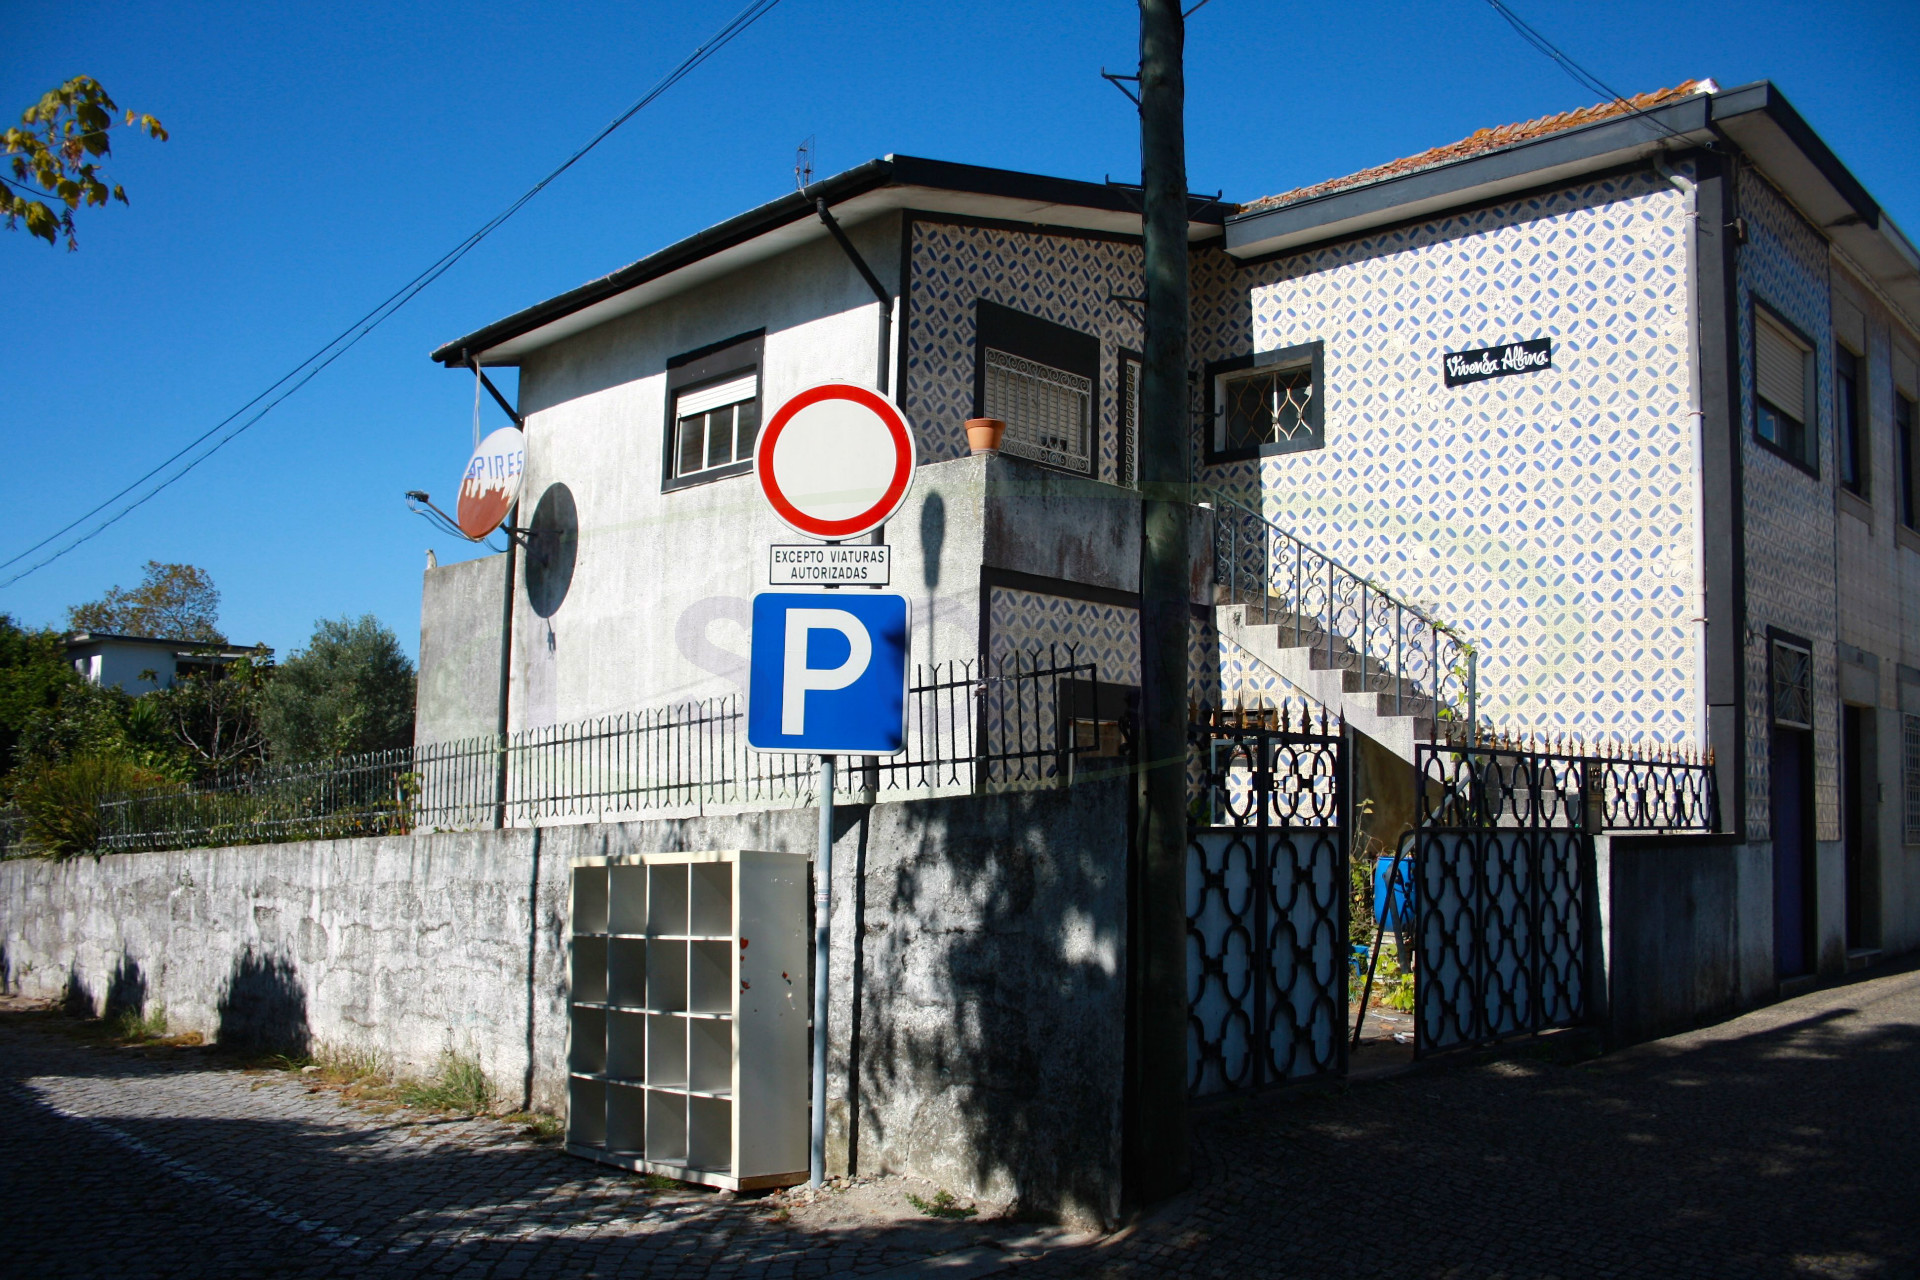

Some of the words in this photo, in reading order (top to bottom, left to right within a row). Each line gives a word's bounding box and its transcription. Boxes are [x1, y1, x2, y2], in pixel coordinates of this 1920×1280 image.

[1446, 352, 1499, 378] Vivenda
[1501, 345, 1549, 371] Albina
[775, 550, 824, 563] EXCEPTO
[830, 550, 885, 563] VIATURAS
[791, 566, 868, 579] AUTORIZADAS
[781, 608, 872, 736] P
